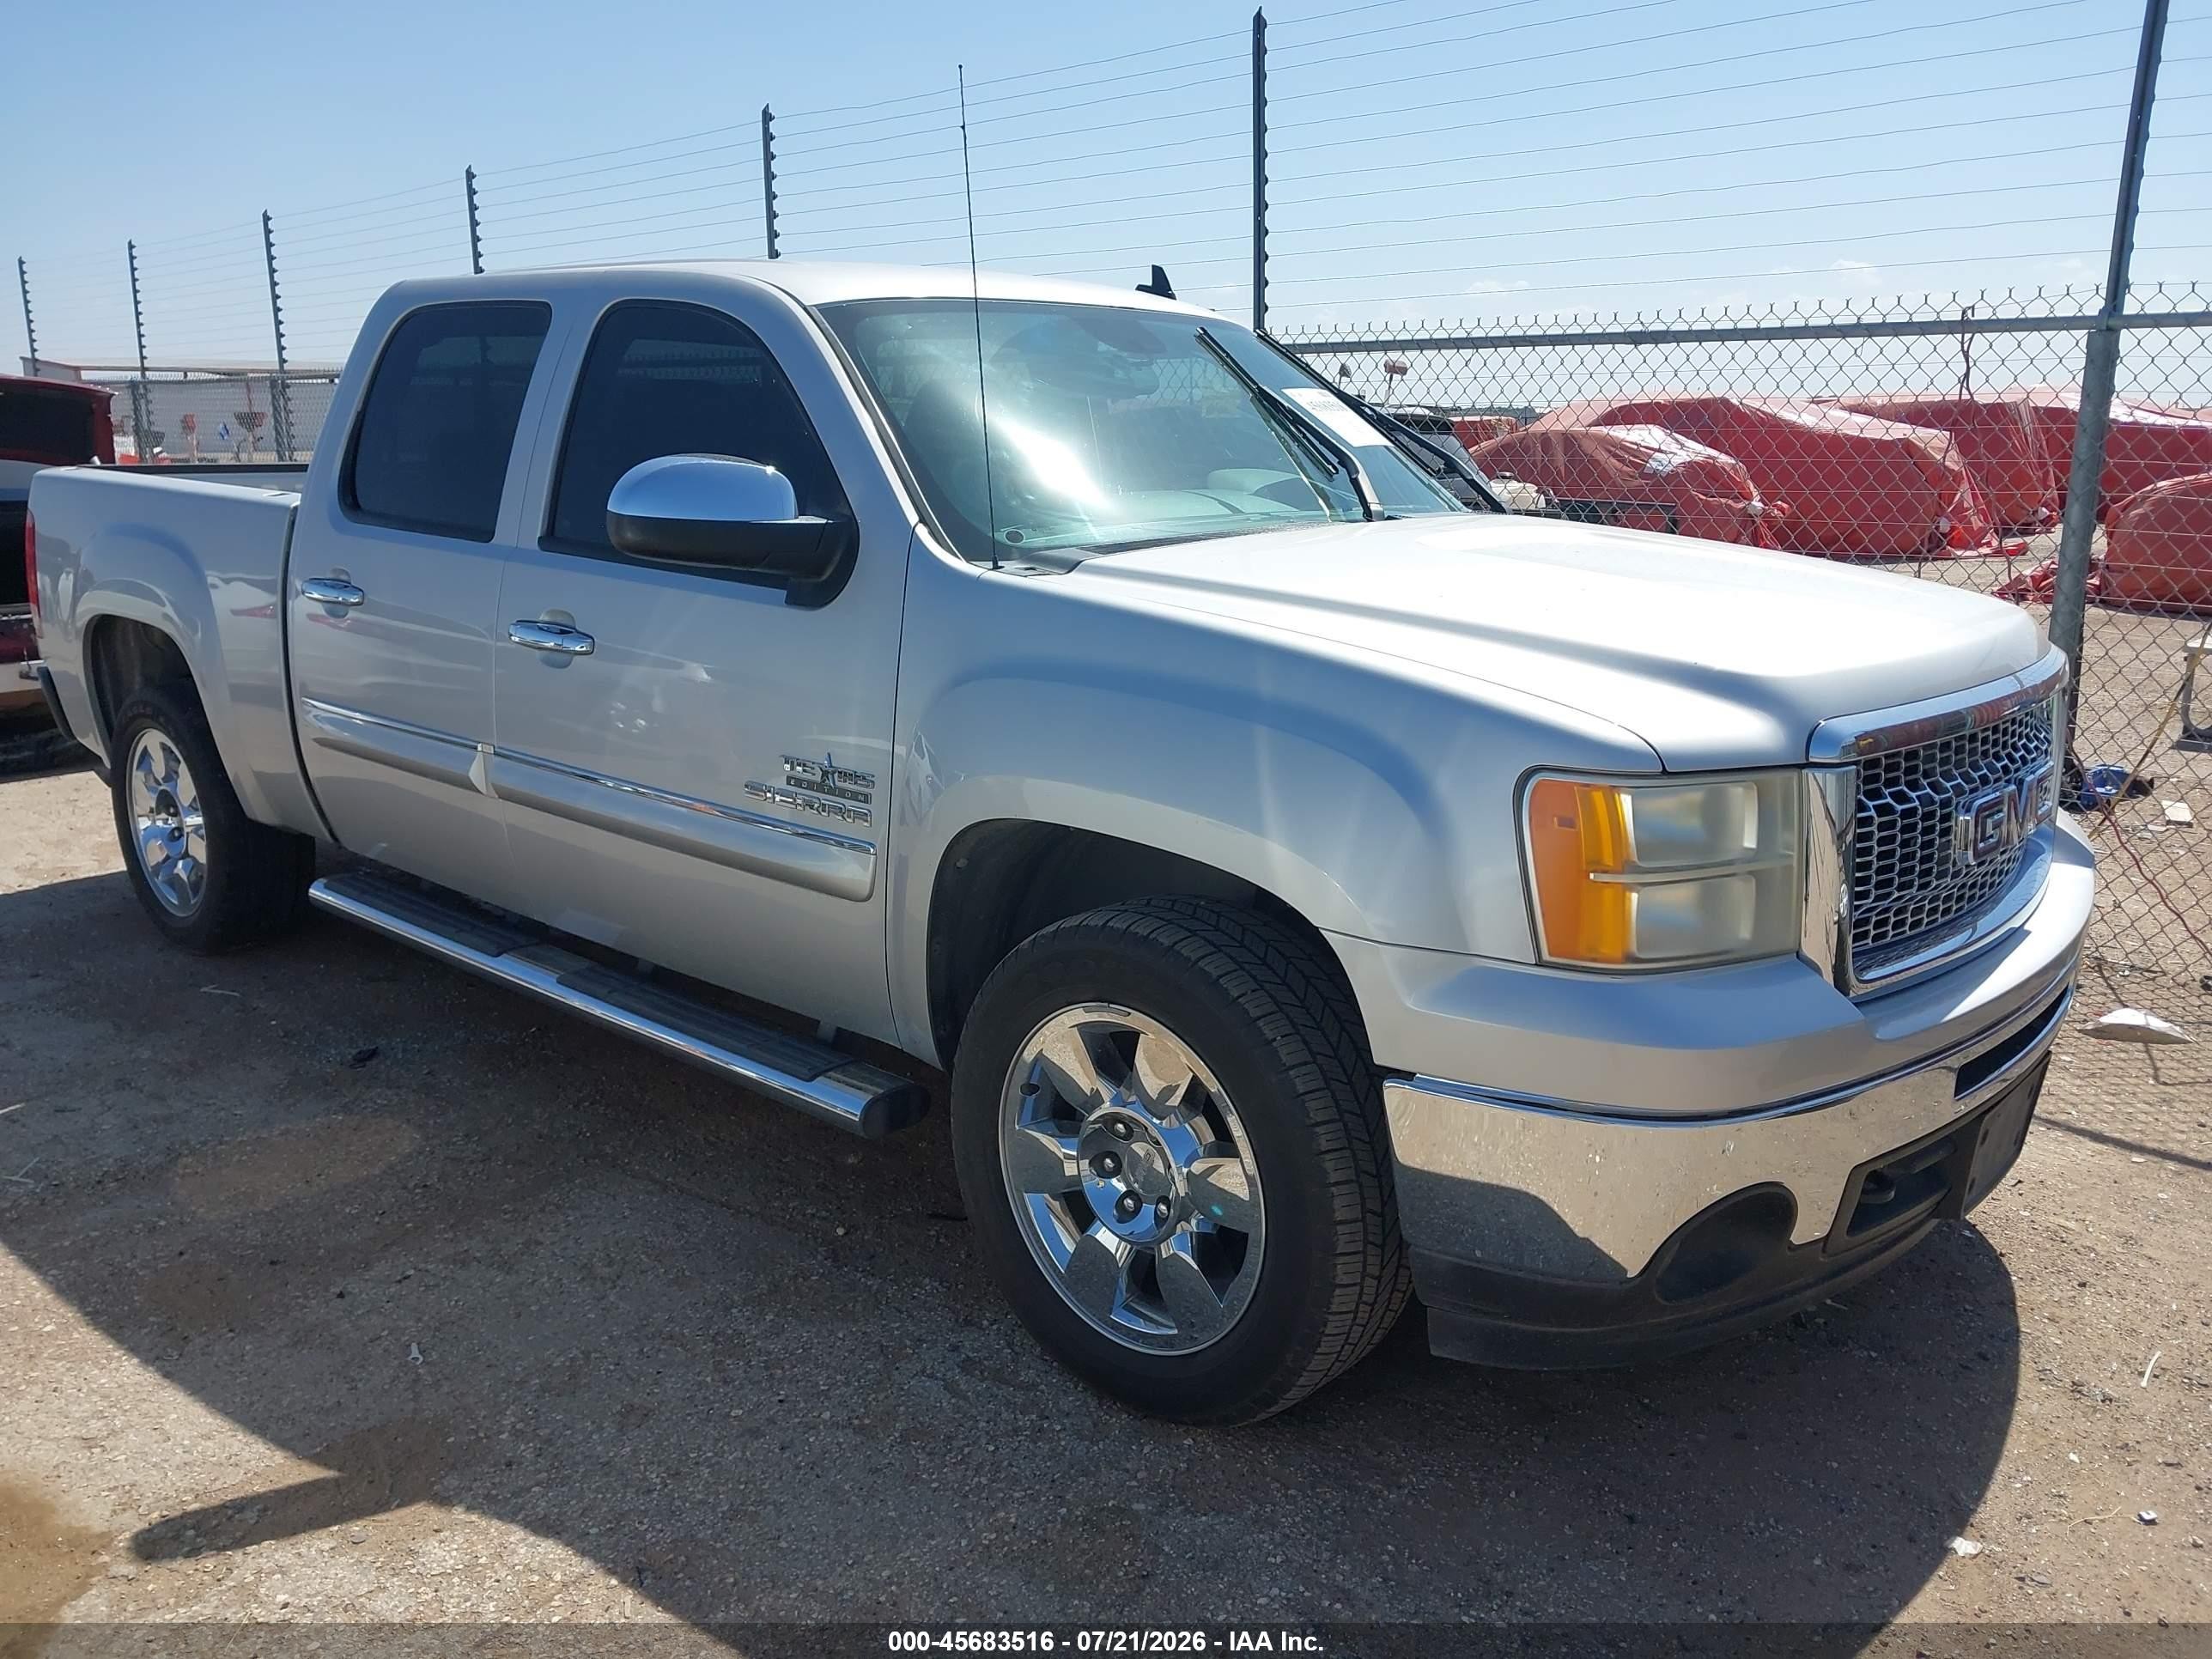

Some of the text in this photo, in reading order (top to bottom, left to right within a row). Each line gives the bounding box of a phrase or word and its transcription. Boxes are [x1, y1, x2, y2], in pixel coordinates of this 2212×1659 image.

[780, 754, 876, 790] TEXAS
[789, 777, 867, 803] EDITION
[744, 780, 872, 828] SIERRA
[1959, 761, 2055, 865] GMC
